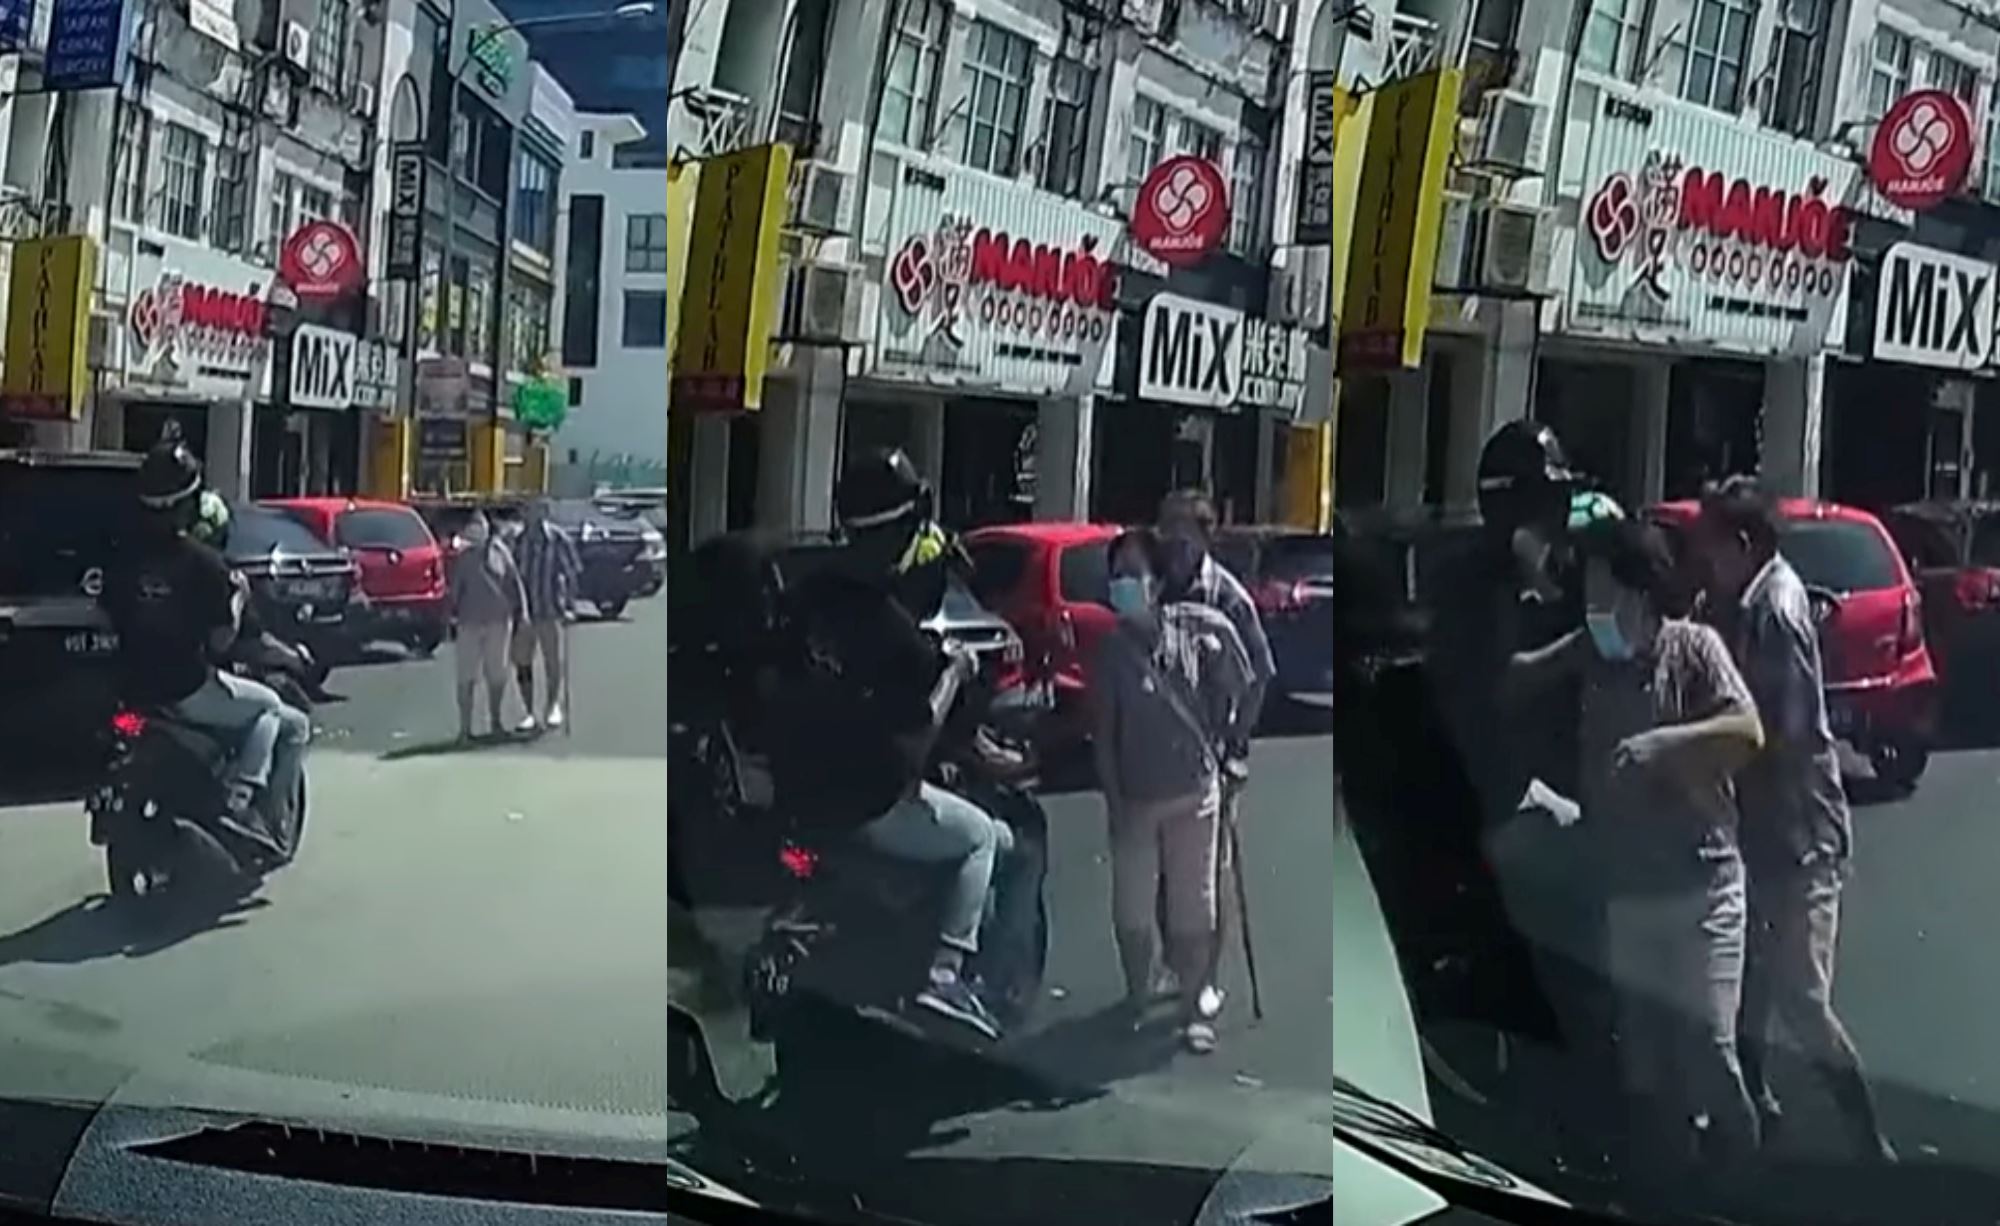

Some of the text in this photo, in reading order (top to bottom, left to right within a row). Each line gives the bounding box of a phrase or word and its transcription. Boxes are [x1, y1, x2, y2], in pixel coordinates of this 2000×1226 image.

[1148, 305, 1239, 395] MiX
[1884, 255, 1990, 356] MiX
[295, 333, 350, 400] MiX
